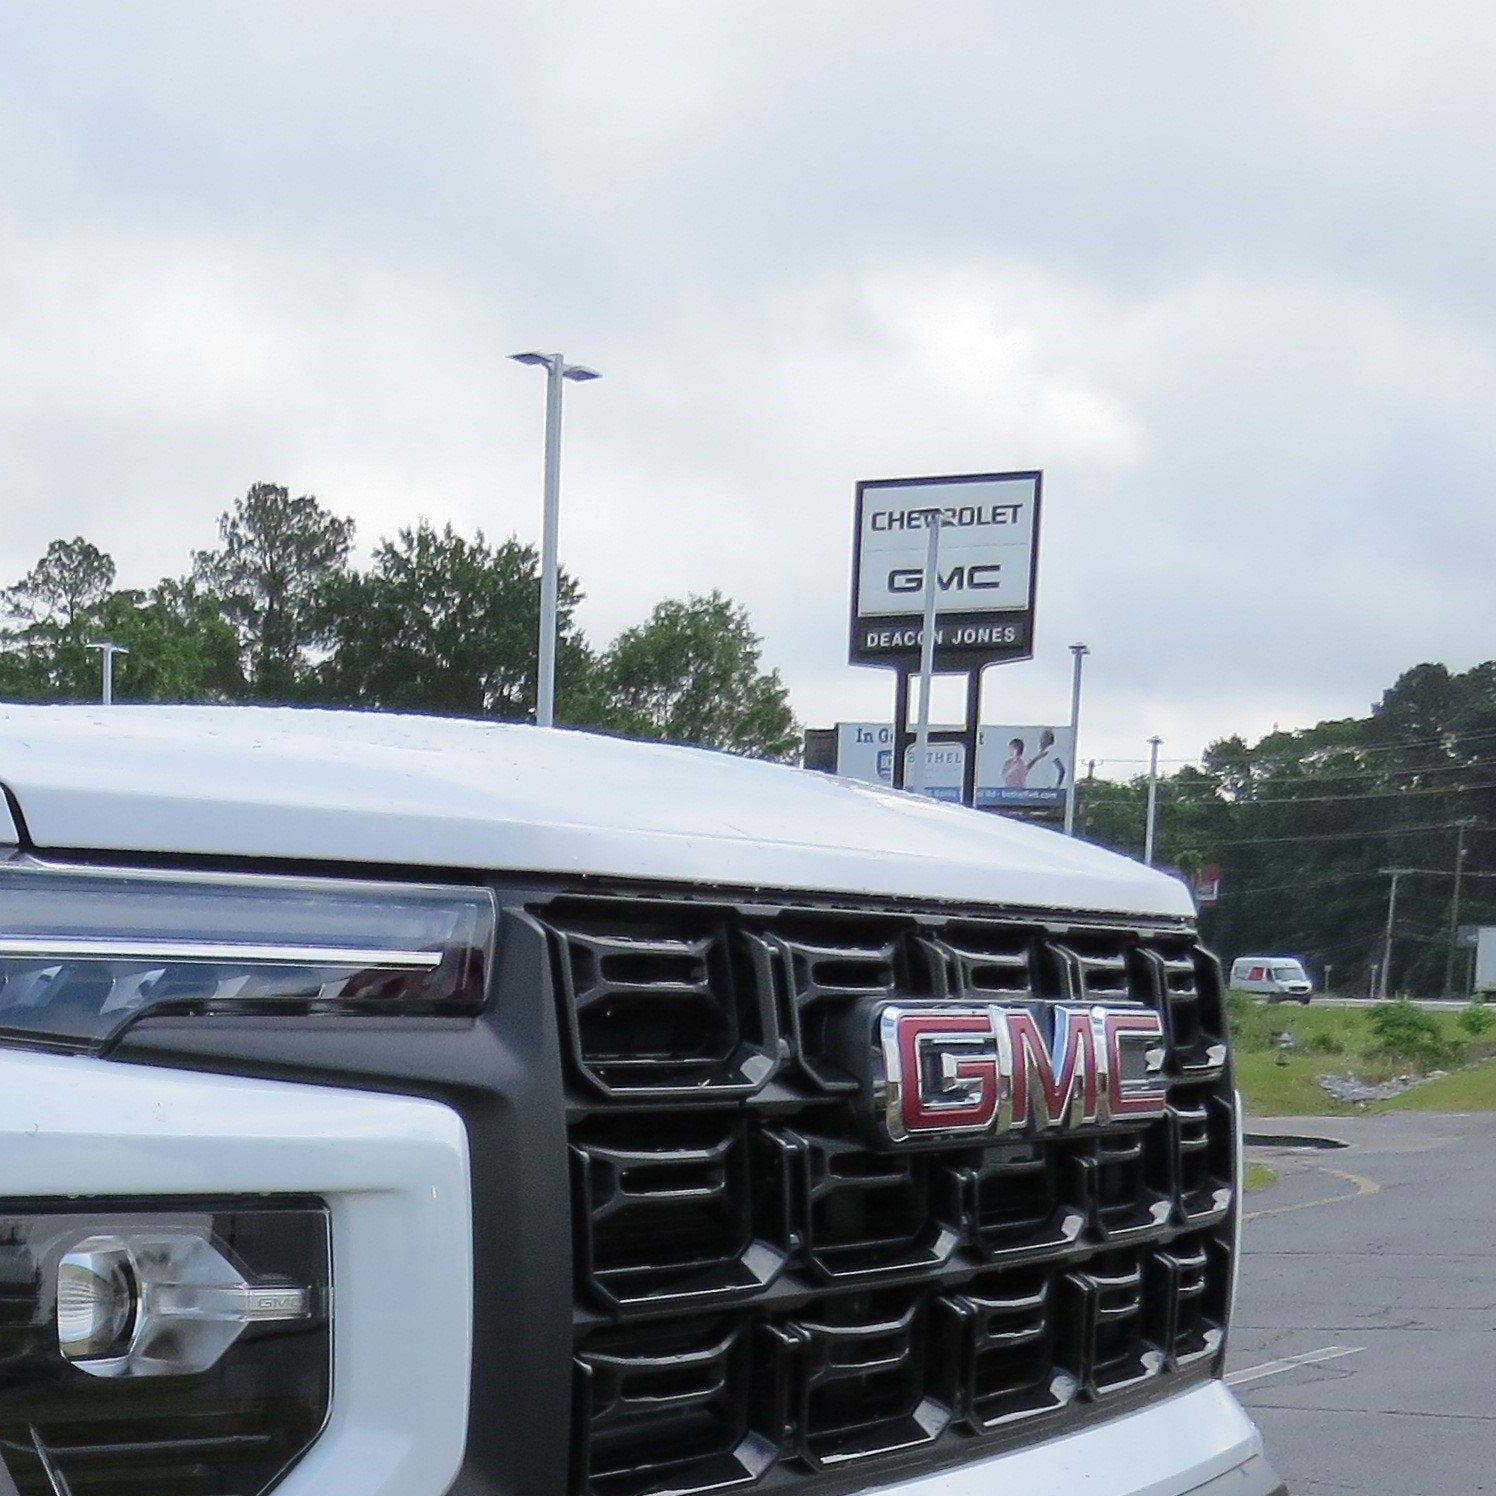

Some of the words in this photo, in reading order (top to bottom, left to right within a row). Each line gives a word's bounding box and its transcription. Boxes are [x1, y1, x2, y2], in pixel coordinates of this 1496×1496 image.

[887, 564, 1002, 594] GMC
[951, 627, 1017, 645] JONES
[856, 728, 874, 743] In
[881, 1003, 1168, 1143] GMC
